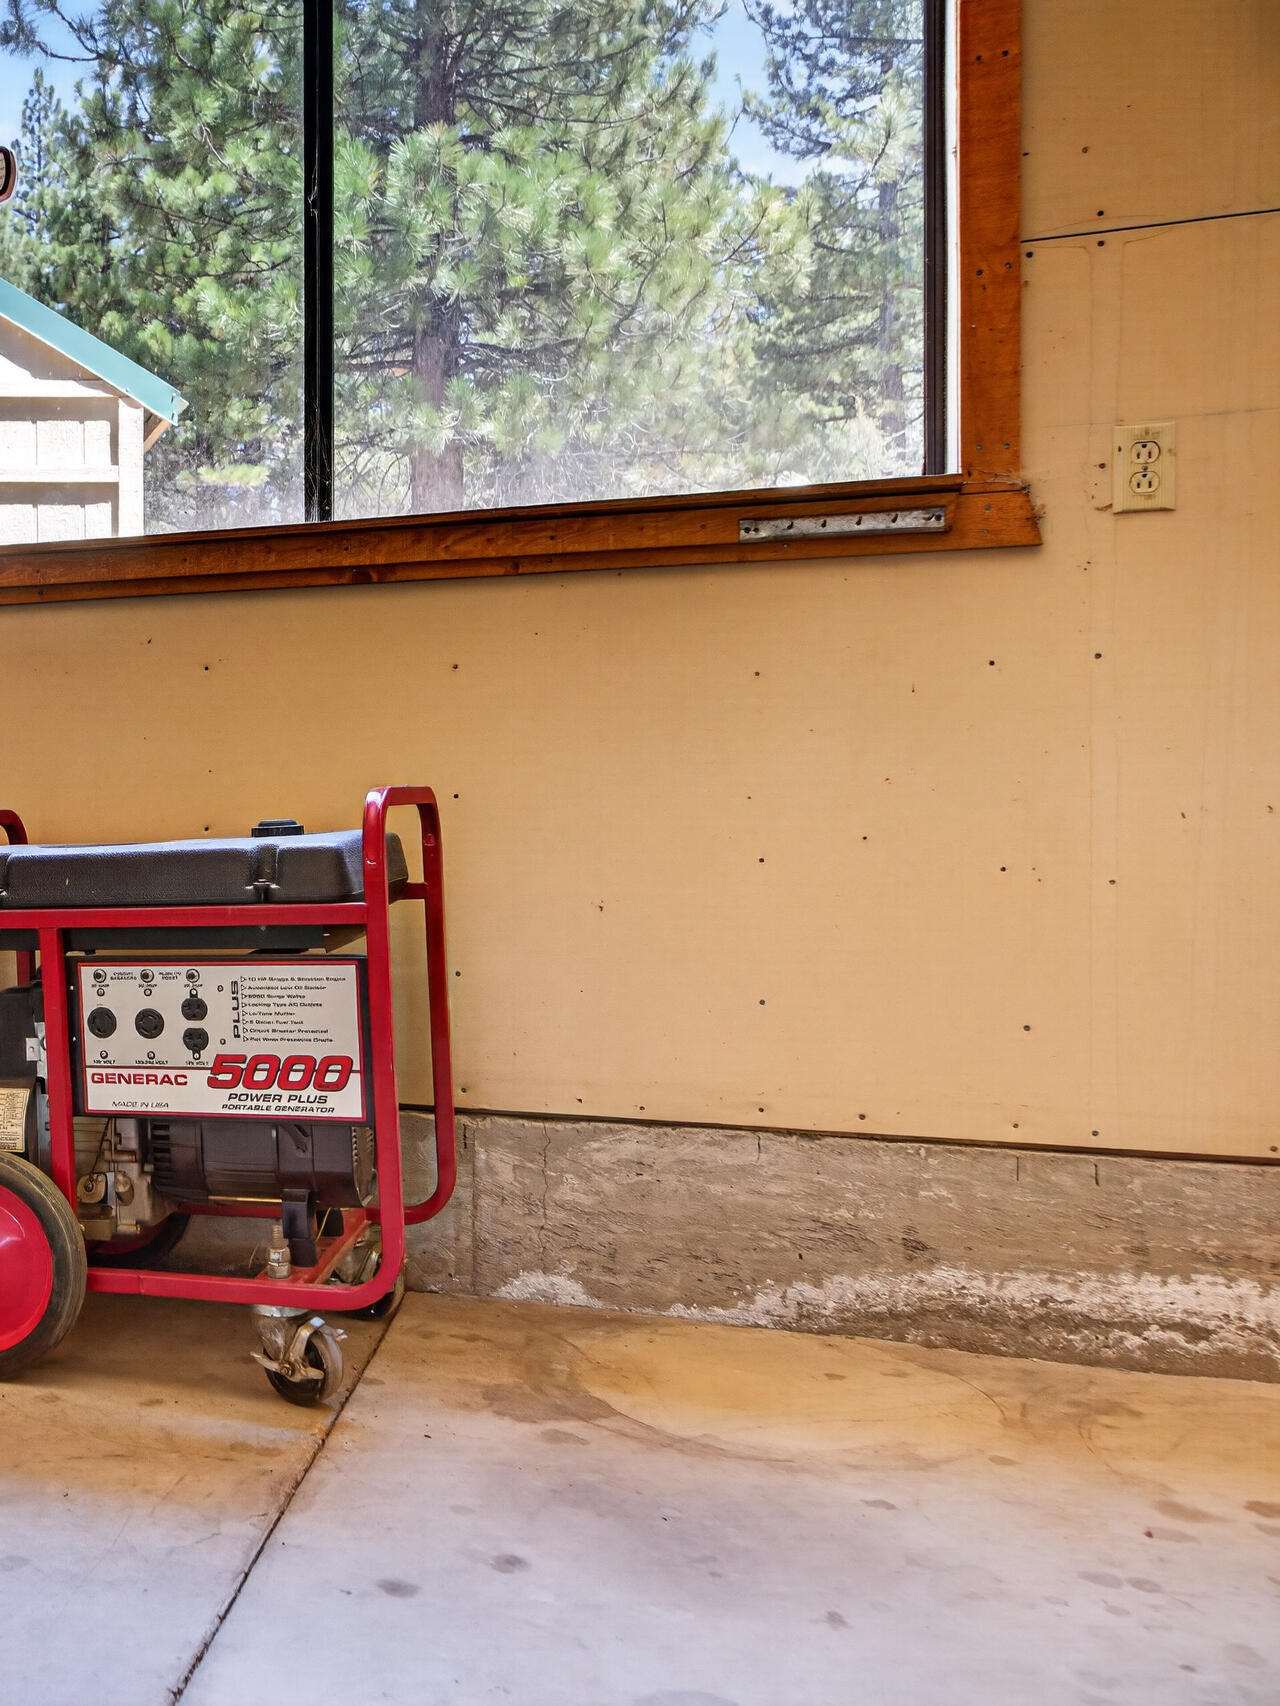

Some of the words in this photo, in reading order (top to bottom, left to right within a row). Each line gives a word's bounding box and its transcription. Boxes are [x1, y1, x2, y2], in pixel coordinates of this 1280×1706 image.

[231, 980, 240, 1039] PLUS
[91, 1072, 188, 1086] GENERAC
[207, 1054, 353, 1092] 5000
[227, 1093, 283, 1103] POWER
[287, 1094, 329, 1104] PLUS
[221, 1104, 272, 1112] PORTABLE
[274, 1105, 335, 1113] GENERATOR
